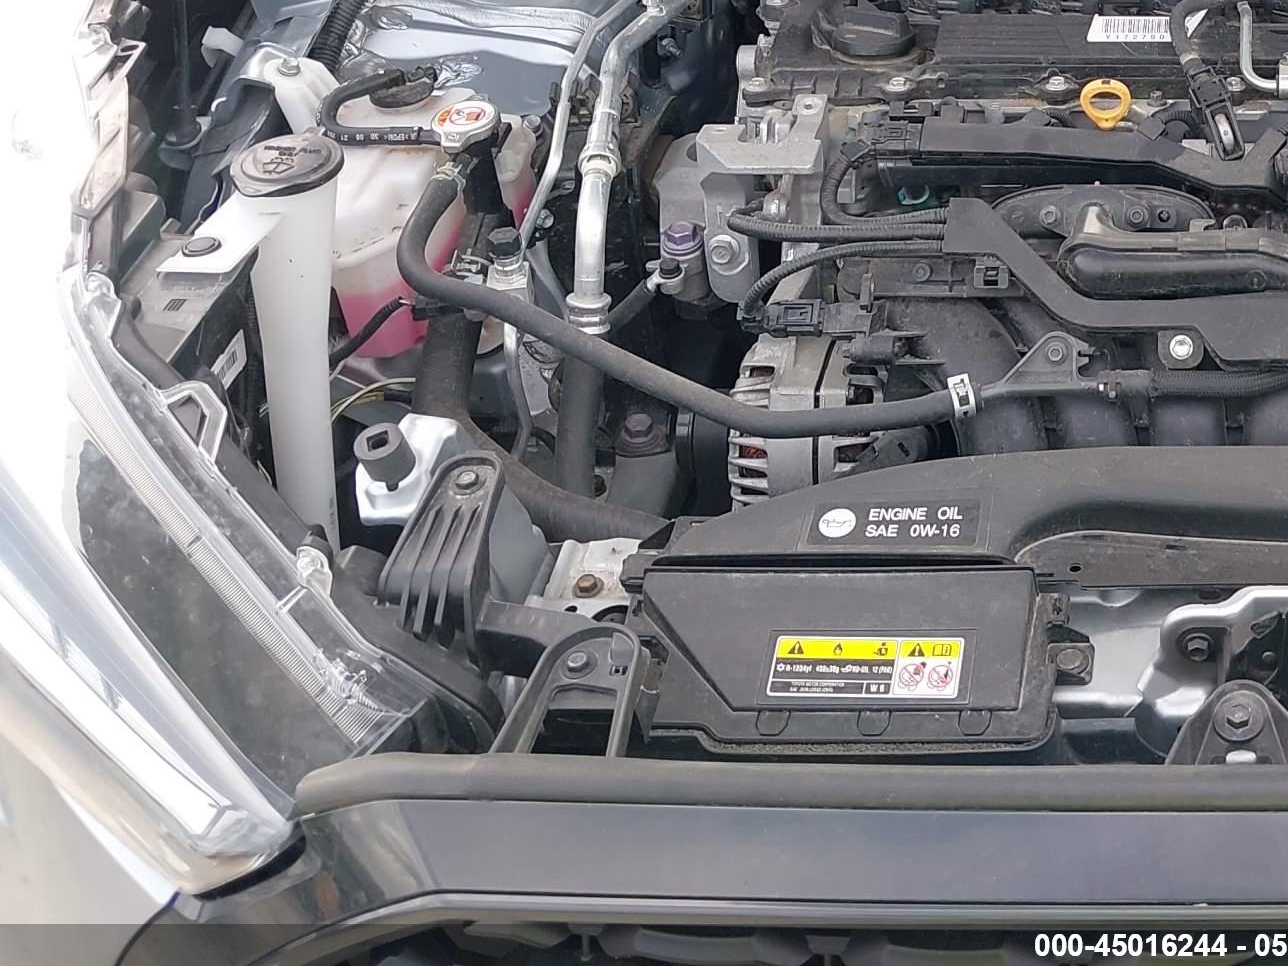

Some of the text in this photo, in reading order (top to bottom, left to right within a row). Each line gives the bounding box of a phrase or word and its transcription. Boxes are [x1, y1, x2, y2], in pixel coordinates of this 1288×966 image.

[868, 506, 963, 521] ENGINE OIL
[865, 524, 961, 538] SAE 0W-16
[870, 684, 879, 692] W
